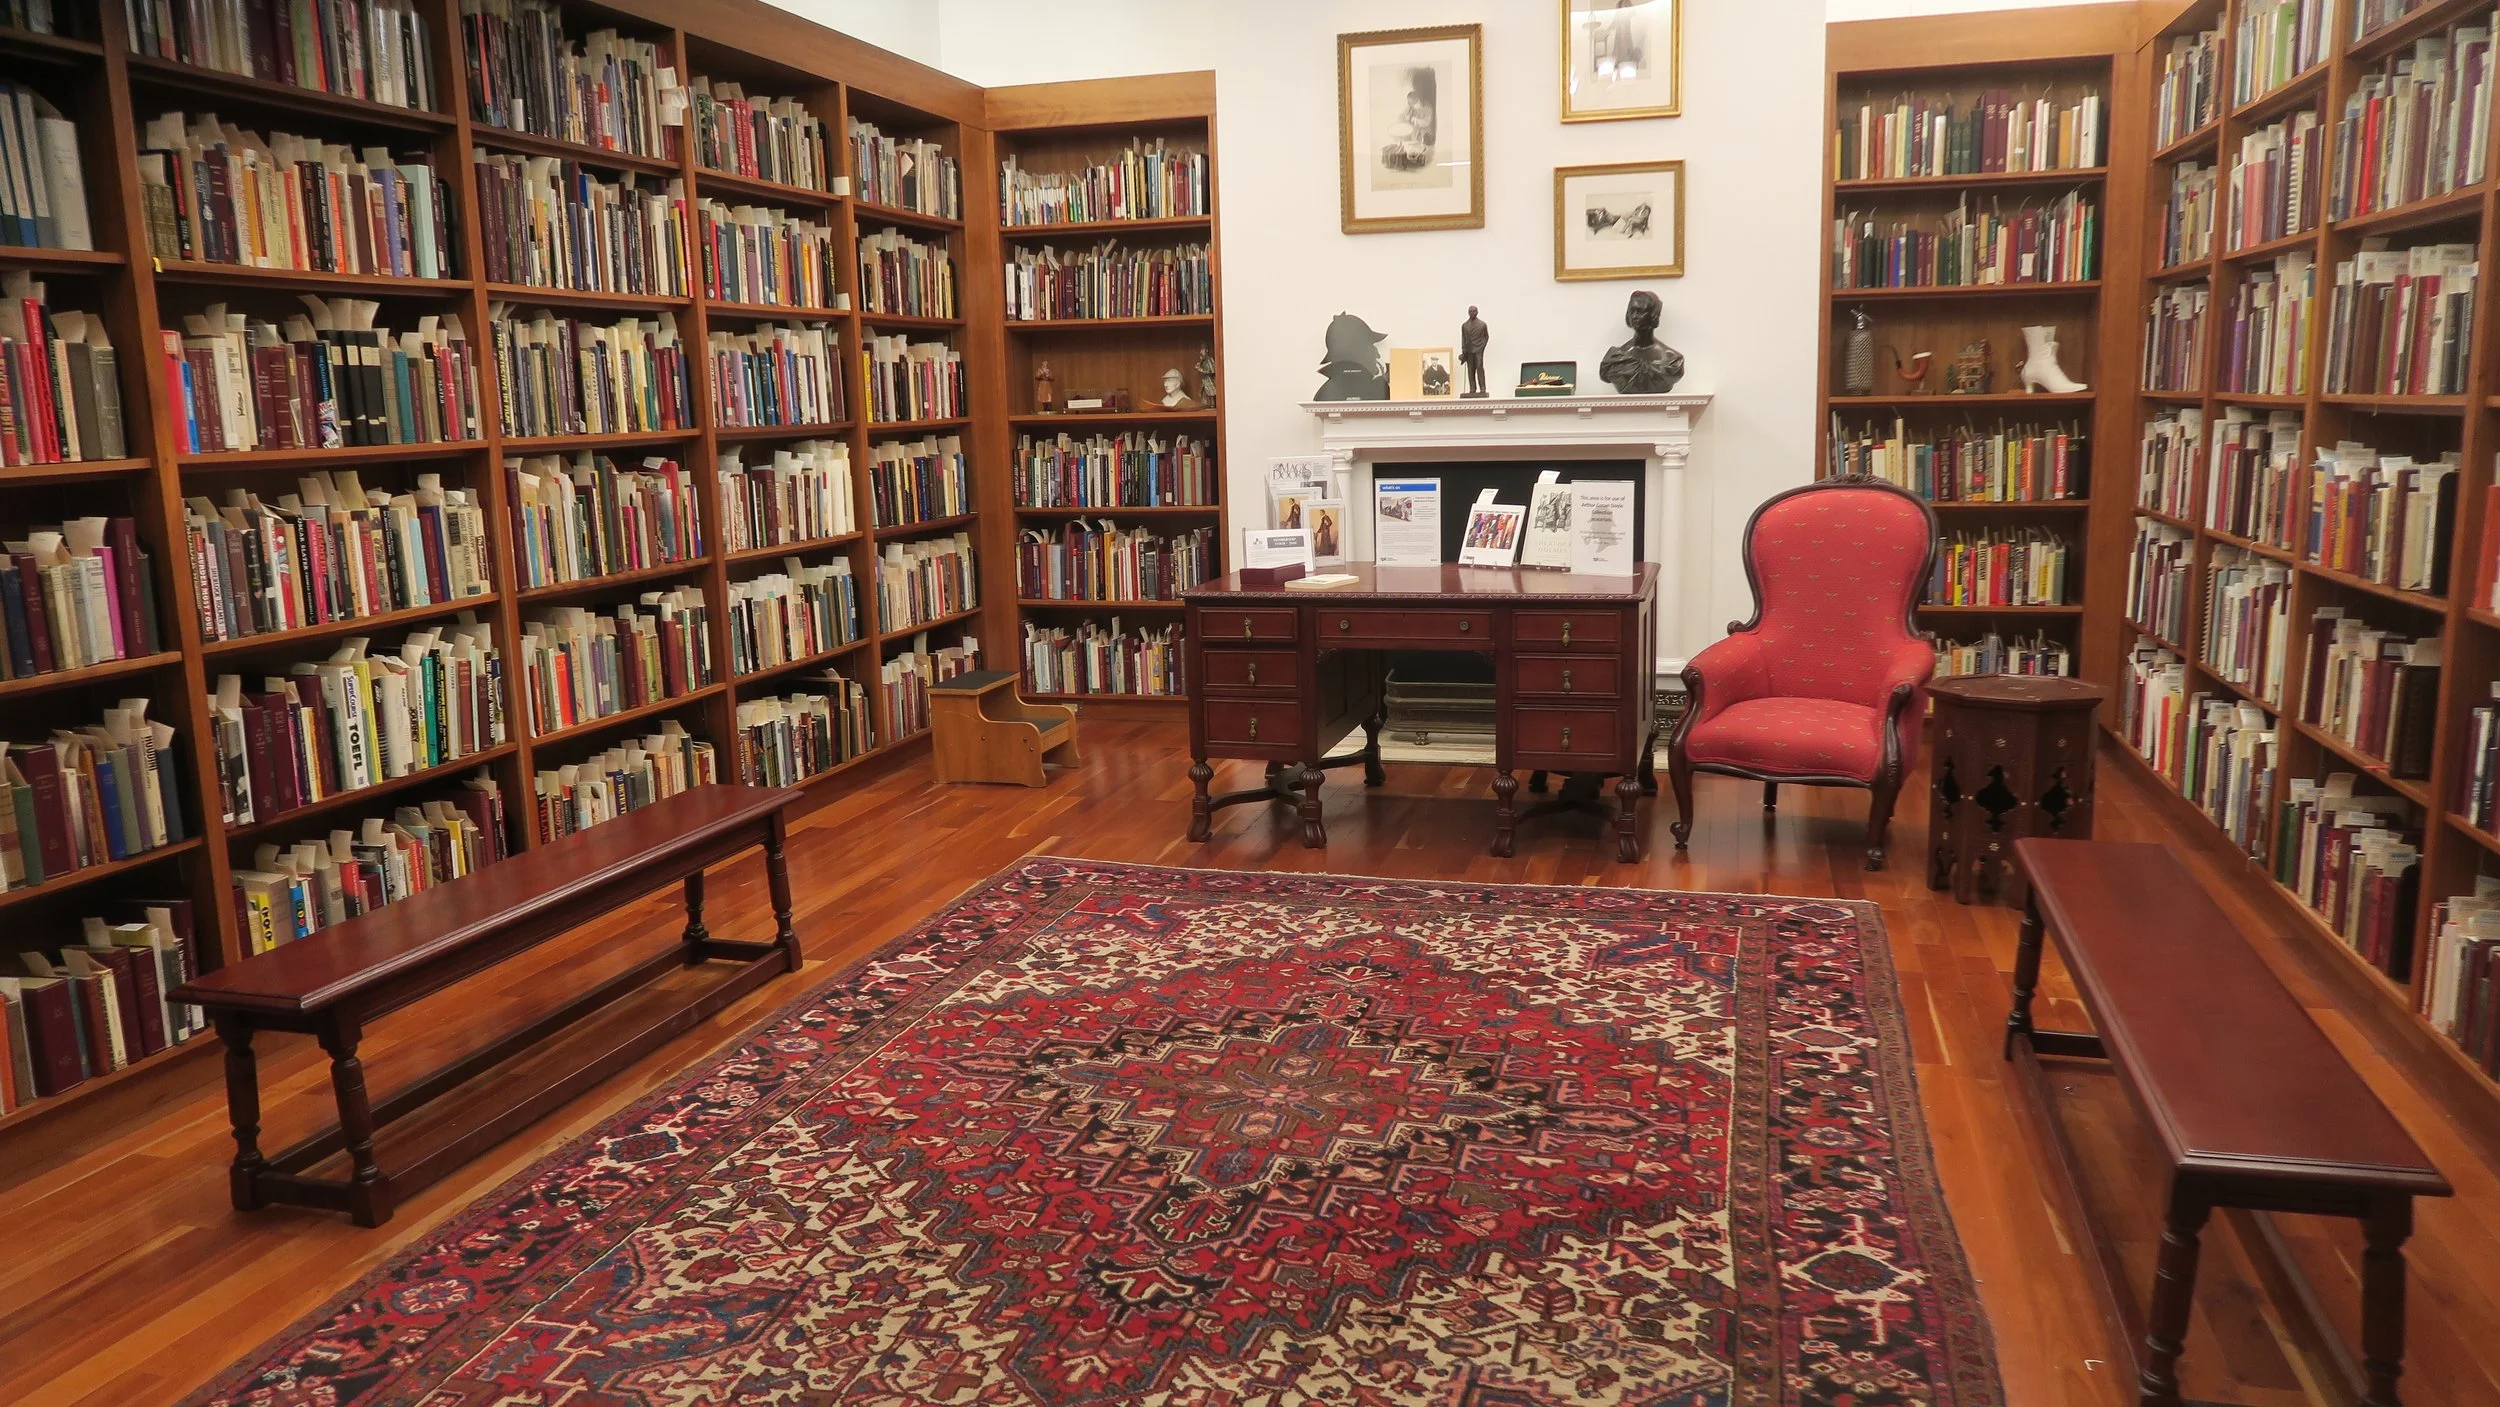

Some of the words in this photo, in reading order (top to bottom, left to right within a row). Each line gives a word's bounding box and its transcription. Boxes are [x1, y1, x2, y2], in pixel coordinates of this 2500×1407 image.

[498, 351, 508, 391] DETECTIVE
[503, 393, 509, 404] IN
[1279, 463, 1312, 473] MAGIC
[197, 552, 207, 586] MURDER
[300, 545, 309, 571] SLATER
[463, 546, 471, 567] RAILWAY
[202, 588, 211, 609] MOST
[205, 612, 214, 631] FOUL
[215, 600, 224, 625] HOLMES
[410, 707, 419, 743] JOURNEY
[144, 736, 157, 771] HOUDINI
[349, 724, 361, 771] TOEFL
[554, 800, 562, 826] Bloody
